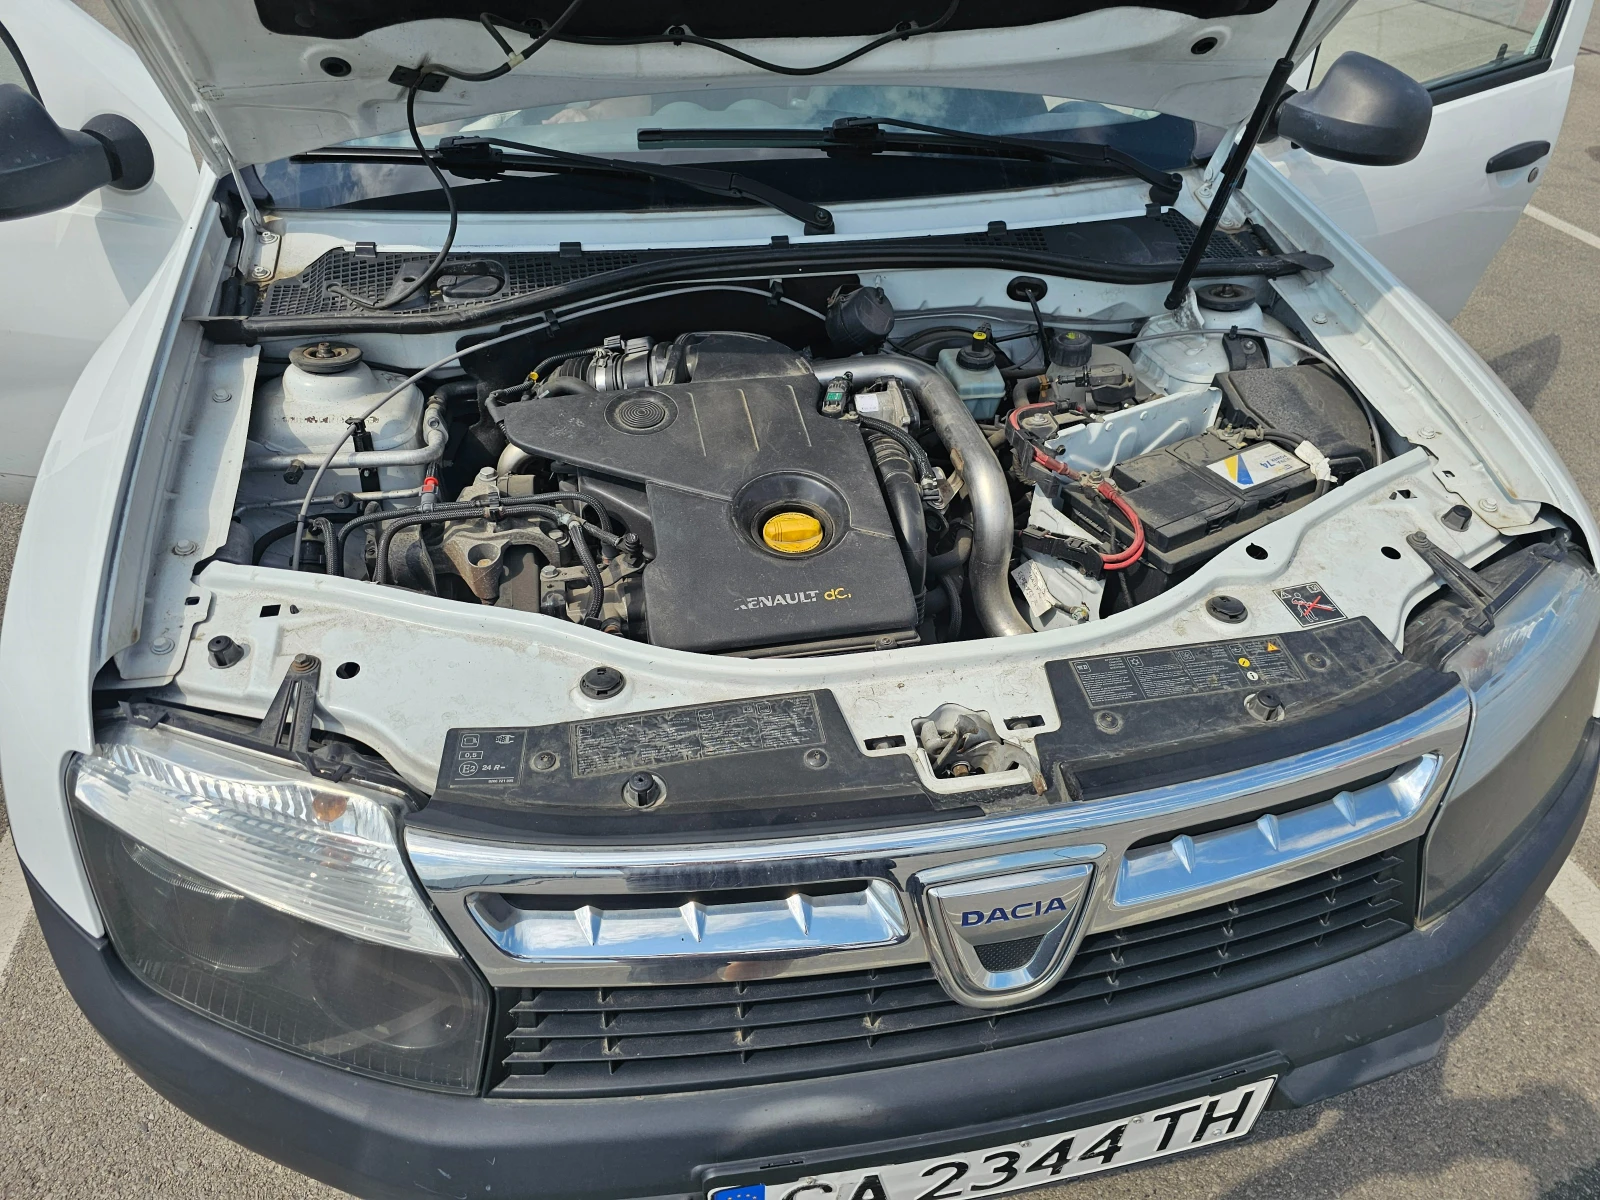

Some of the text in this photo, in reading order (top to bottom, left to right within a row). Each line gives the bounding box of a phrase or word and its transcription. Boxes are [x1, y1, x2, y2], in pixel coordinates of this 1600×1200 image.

[462, 764, 476, 773] E2
[961, 898, 1067, 927] DACIA
[915, 1123, 1129, 1200] 2344
[1153, 1089, 1256, 1151] TH
